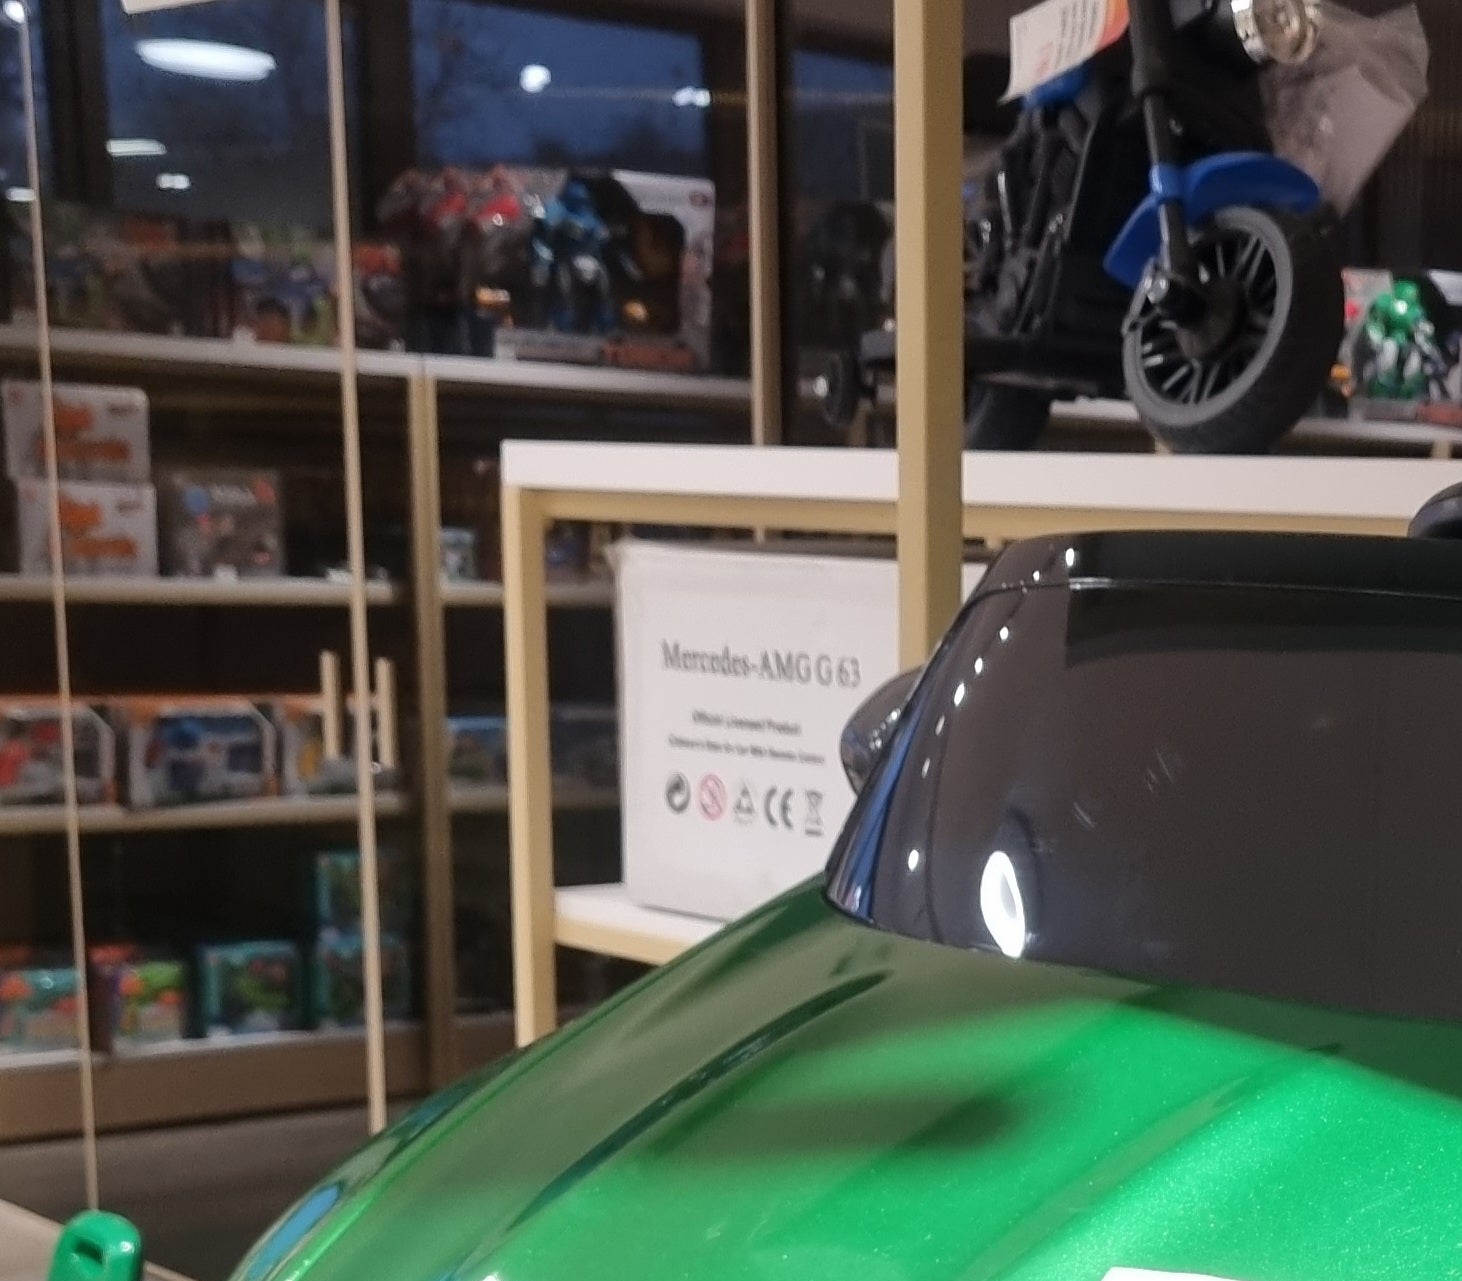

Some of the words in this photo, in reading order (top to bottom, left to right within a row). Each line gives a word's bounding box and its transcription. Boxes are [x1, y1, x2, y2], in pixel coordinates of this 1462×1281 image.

[661, 638, 811, 685] Mercedes-AMG
[816, 653, 833, 686] G
[837, 655, 861, 689] 63
